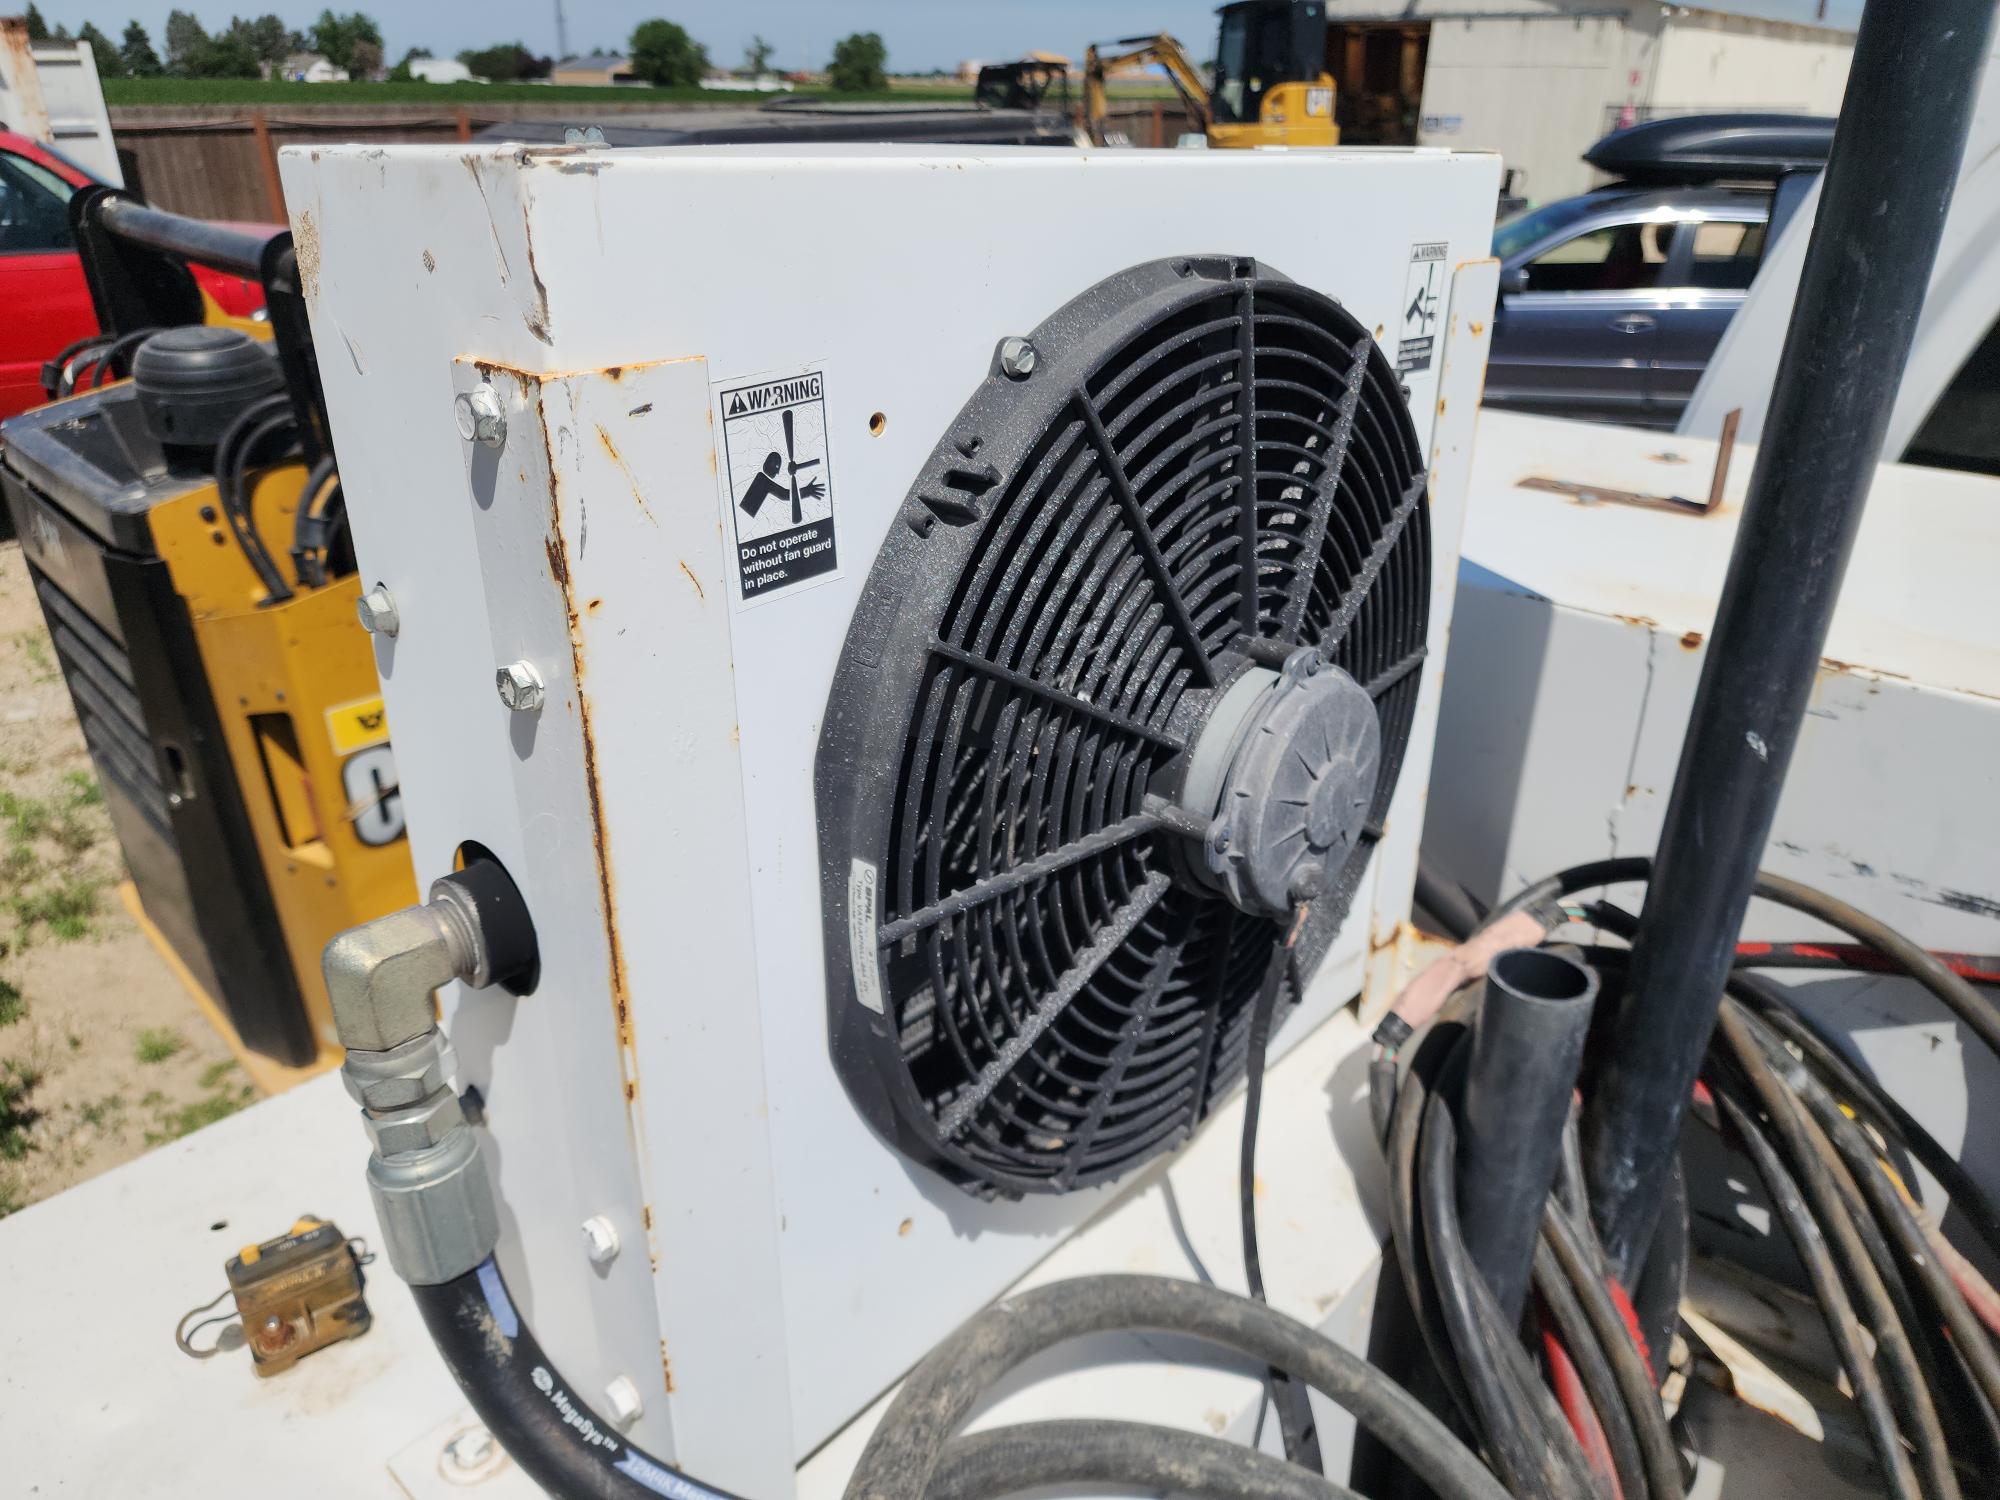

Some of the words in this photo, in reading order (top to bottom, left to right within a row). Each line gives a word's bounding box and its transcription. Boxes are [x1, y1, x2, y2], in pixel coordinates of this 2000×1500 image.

[747, 378, 820, 410] WARNING
[741, 548, 757, 560] Do
[759, 540, 777, 555] not
[779, 529, 818, 549] operate
[742, 553, 783, 575] without
[784, 549, 801, 562] fan
[802, 537, 832, 558] guard
[744, 580, 755, 590] in
[756, 570, 788, 588] place.
